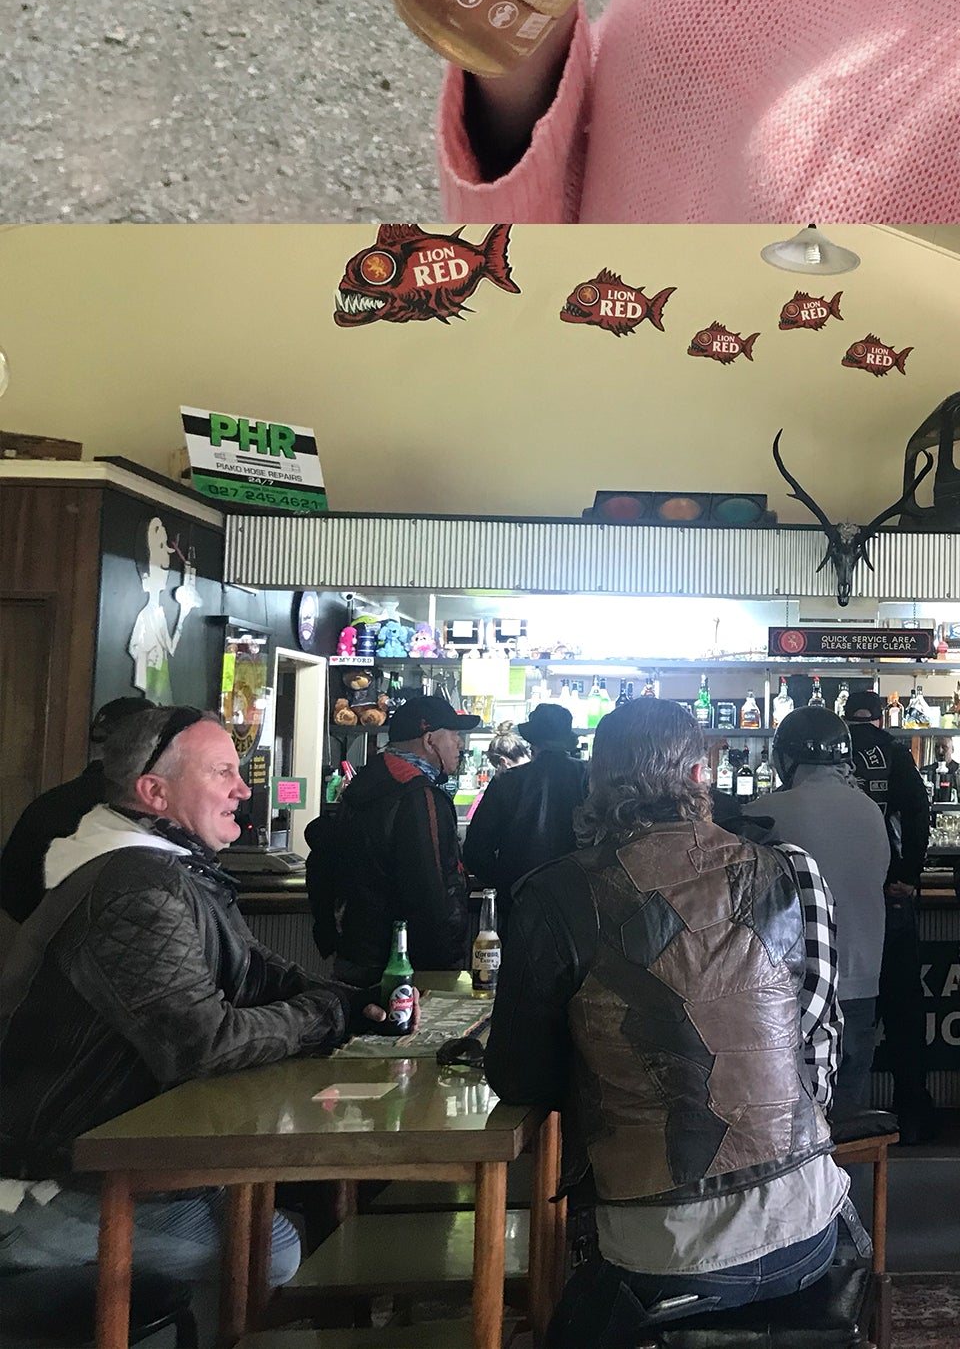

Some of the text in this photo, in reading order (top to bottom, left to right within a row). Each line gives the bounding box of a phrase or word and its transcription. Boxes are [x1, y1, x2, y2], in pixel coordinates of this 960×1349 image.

[419, 246, 455, 264] LION
[413, 258, 469, 287] RED
[607, 290, 635, 301] LION
[600, 300, 642, 319] RED
[803, 301, 821, 309] LION
[800, 307, 828, 321] RED
[717, 334, 735, 343] LION
[712, 341, 739, 353] RED
[871, 347, 889, 355] LION
[866, 353, 893, 366] RED
[209, 413, 296, 459] PHR
[216, 462, 303, 482] PIAKO HOSE REPAIRS
[208, 484, 238, 497] 027
[245, 490, 276, 502] 245
[821, 635, 848, 643] QUICK
[851, 635, 887, 643] SERVICE
[856, 642, 879, 650] KEEP
[865, 747, 879, 765] der
